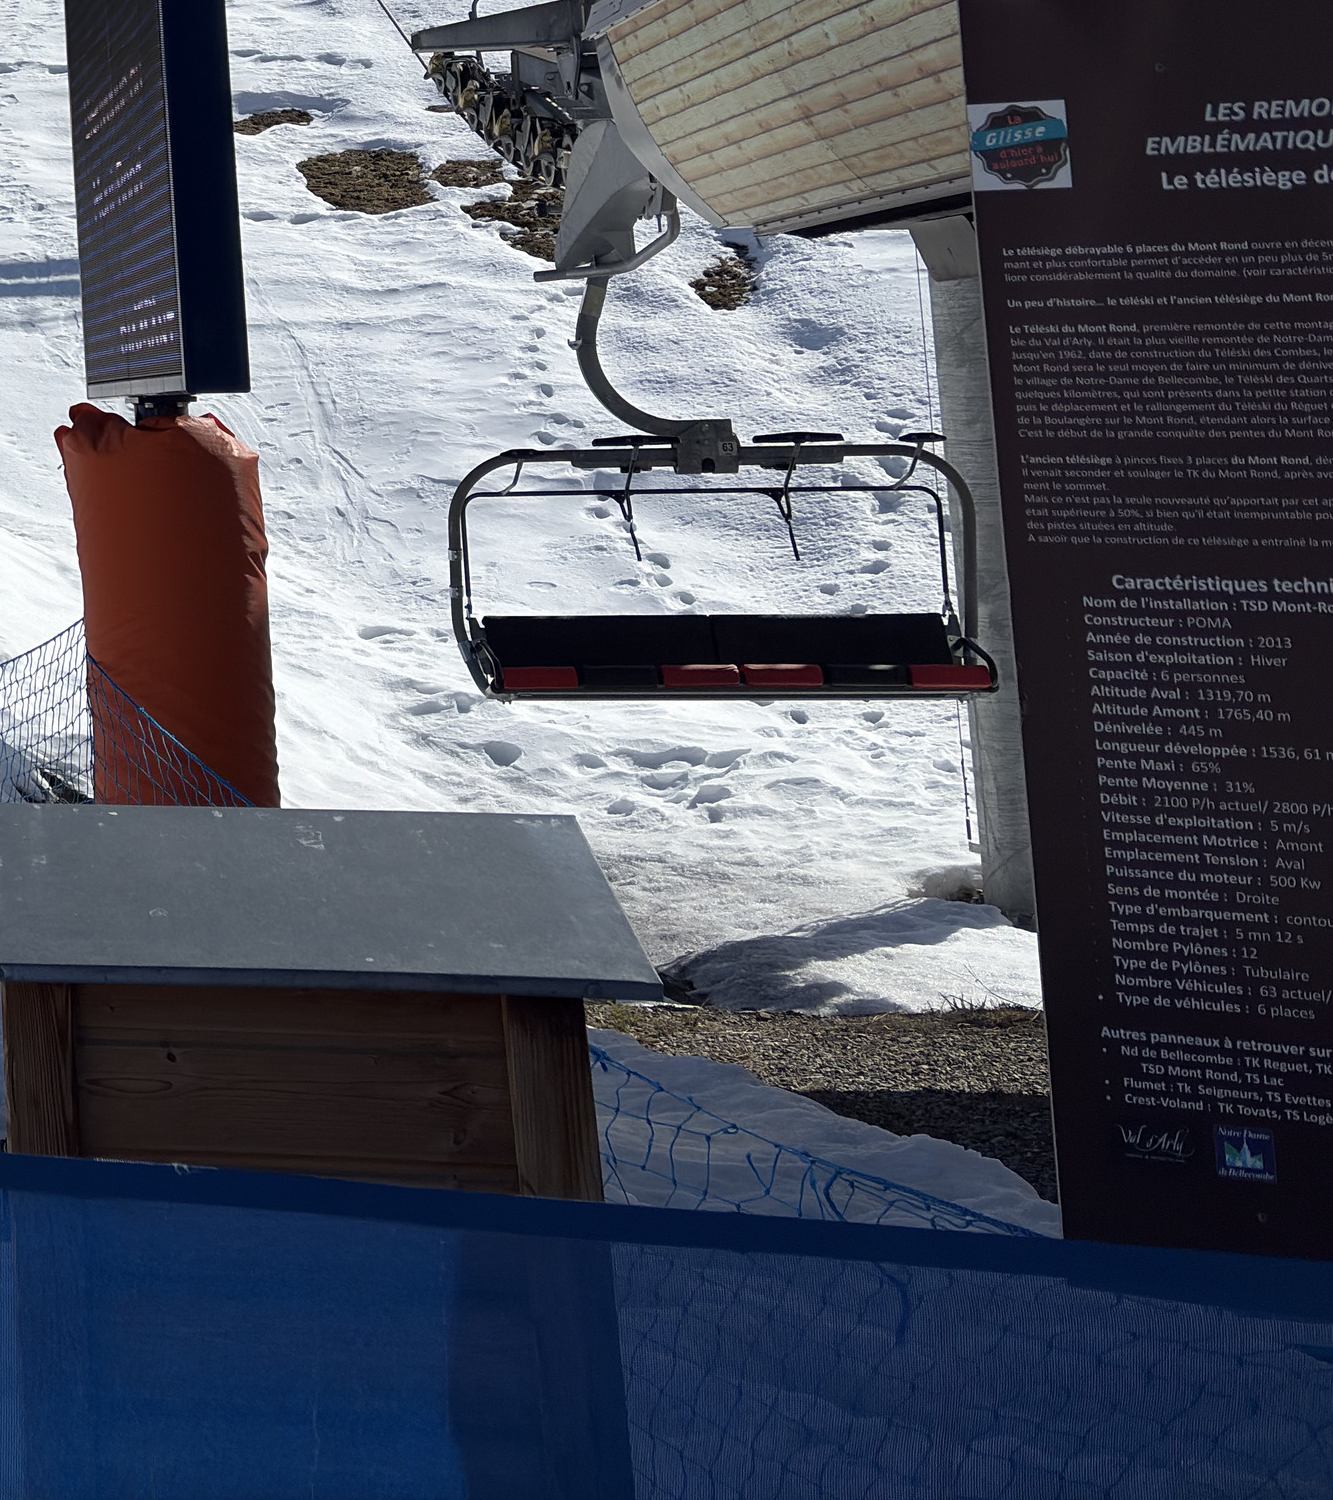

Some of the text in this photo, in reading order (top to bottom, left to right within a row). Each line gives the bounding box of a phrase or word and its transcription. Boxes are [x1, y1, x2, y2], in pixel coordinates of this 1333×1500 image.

[1008, 115, 1022, 125] La
[1204, 97, 1333, 121] LES REMO
[986, 126, 1046, 146] Glisse
[1145, 128, 1333, 155] EMBLÉMATIQU
[1161, 164, 1333, 189] Le télésiège d
[1002, 248, 1014, 256] Le
[1016, 246, 1062, 257] télésiège
[1064, 244, 1123, 255] débrayable
[1126, 244, 1133, 252] 6
[1135, 243, 1169, 254] places
[1170, 242, 1185, 251] du
[1187, 242, 1217, 251] Mont
[1220, 240, 1248, 250] Rond
[722, 442, 734, 452] 63
[1111, 574, 1268, 595] Caractéristiques
[1082, 596, 1116, 608] Nom
[1120, 596, 1137, 608] de
[1141, 596, 1228, 610] l'installation
[1240, 600, 1268, 611] TSD
[1084, 613, 1232, 628] Constructeur POMA
[1085, 631, 1292, 648] Année de construction 2013
[1087, 649, 1287, 666] Saison d'exploitation Hiver
[1088, 667, 1245, 686] Capacité 6 personnes
[1090, 684, 1270, 702] Altitude Aval 1319,70 m
[1092, 702, 1290, 722] Altitude Amont 1765,40 m
[1093, 720, 1222, 737] Dénivelée 445 m
[1095, 738, 1160, 753] Longueur
[1164, 741, 1247, 758] développée
[1261, 746, 1299, 760] 1536,
[1303, 748, 1321, 760] 61
[1097, 756, 1220, 773] Pente Maxi 65%
[1098, 774, 1255, 793] Pente Moyenne 31%
[1099, 792, 1138, 805] Débit
[1154, 795, 1188, 808] 2100
[1191, 797, 1215, 810] P/h
[1219, 800, 1268, 814] actuel/
[1273, 801, 1308, 814] 2800
[1100, 810, 1310, 834] Vitesse d'exploitation 5 m/s
[1103, 828, 1323, 852] Emplacement Motrice Amont
[1104, 846, 1304, 870] Emplacement Tension Aval
[1106, 864, 1321, 889] Puissance du moteur 500 Kw
[1107, 883, 1279, 905] Sens de montée Droite
[1108, 900, 1141, 915] Type
[1145, 903, 1269, 923] d'embarquement
[1109, 918, 1303, 943] Temps de trajet 5 mn 12 s
[1111, 937, 1257, 959] Nombre Pylônes 12
[1113, 955, 1309, 981] Type de Pylônes Tubulaire
[1114, 973, 1332, 1004] Nombre Véhicules 63 actuel/
[1115, 991, 1315, 1019] Type de véhicules 6 places
[1100, 1026, 1332, 1058] Autres panneaux à retrouver sur
[1121, 1045, 1332, 1074] Nd de Bellecombe TK Reguet, TK
[1140, 1063, 1284, 1086] TSD Mont Rond, TS Lac
[1123, 1077, 1331, 1107] Flumet Tk Seigneurs, TS Evettes
[1124, 1093, 1203, 1110] Crest-Voland
[1217, 1102, 1234, 1114] TK
[1236, 1104, 1281, 1120] Tovats,
[1284, 1109, 1300, 1120] TS
